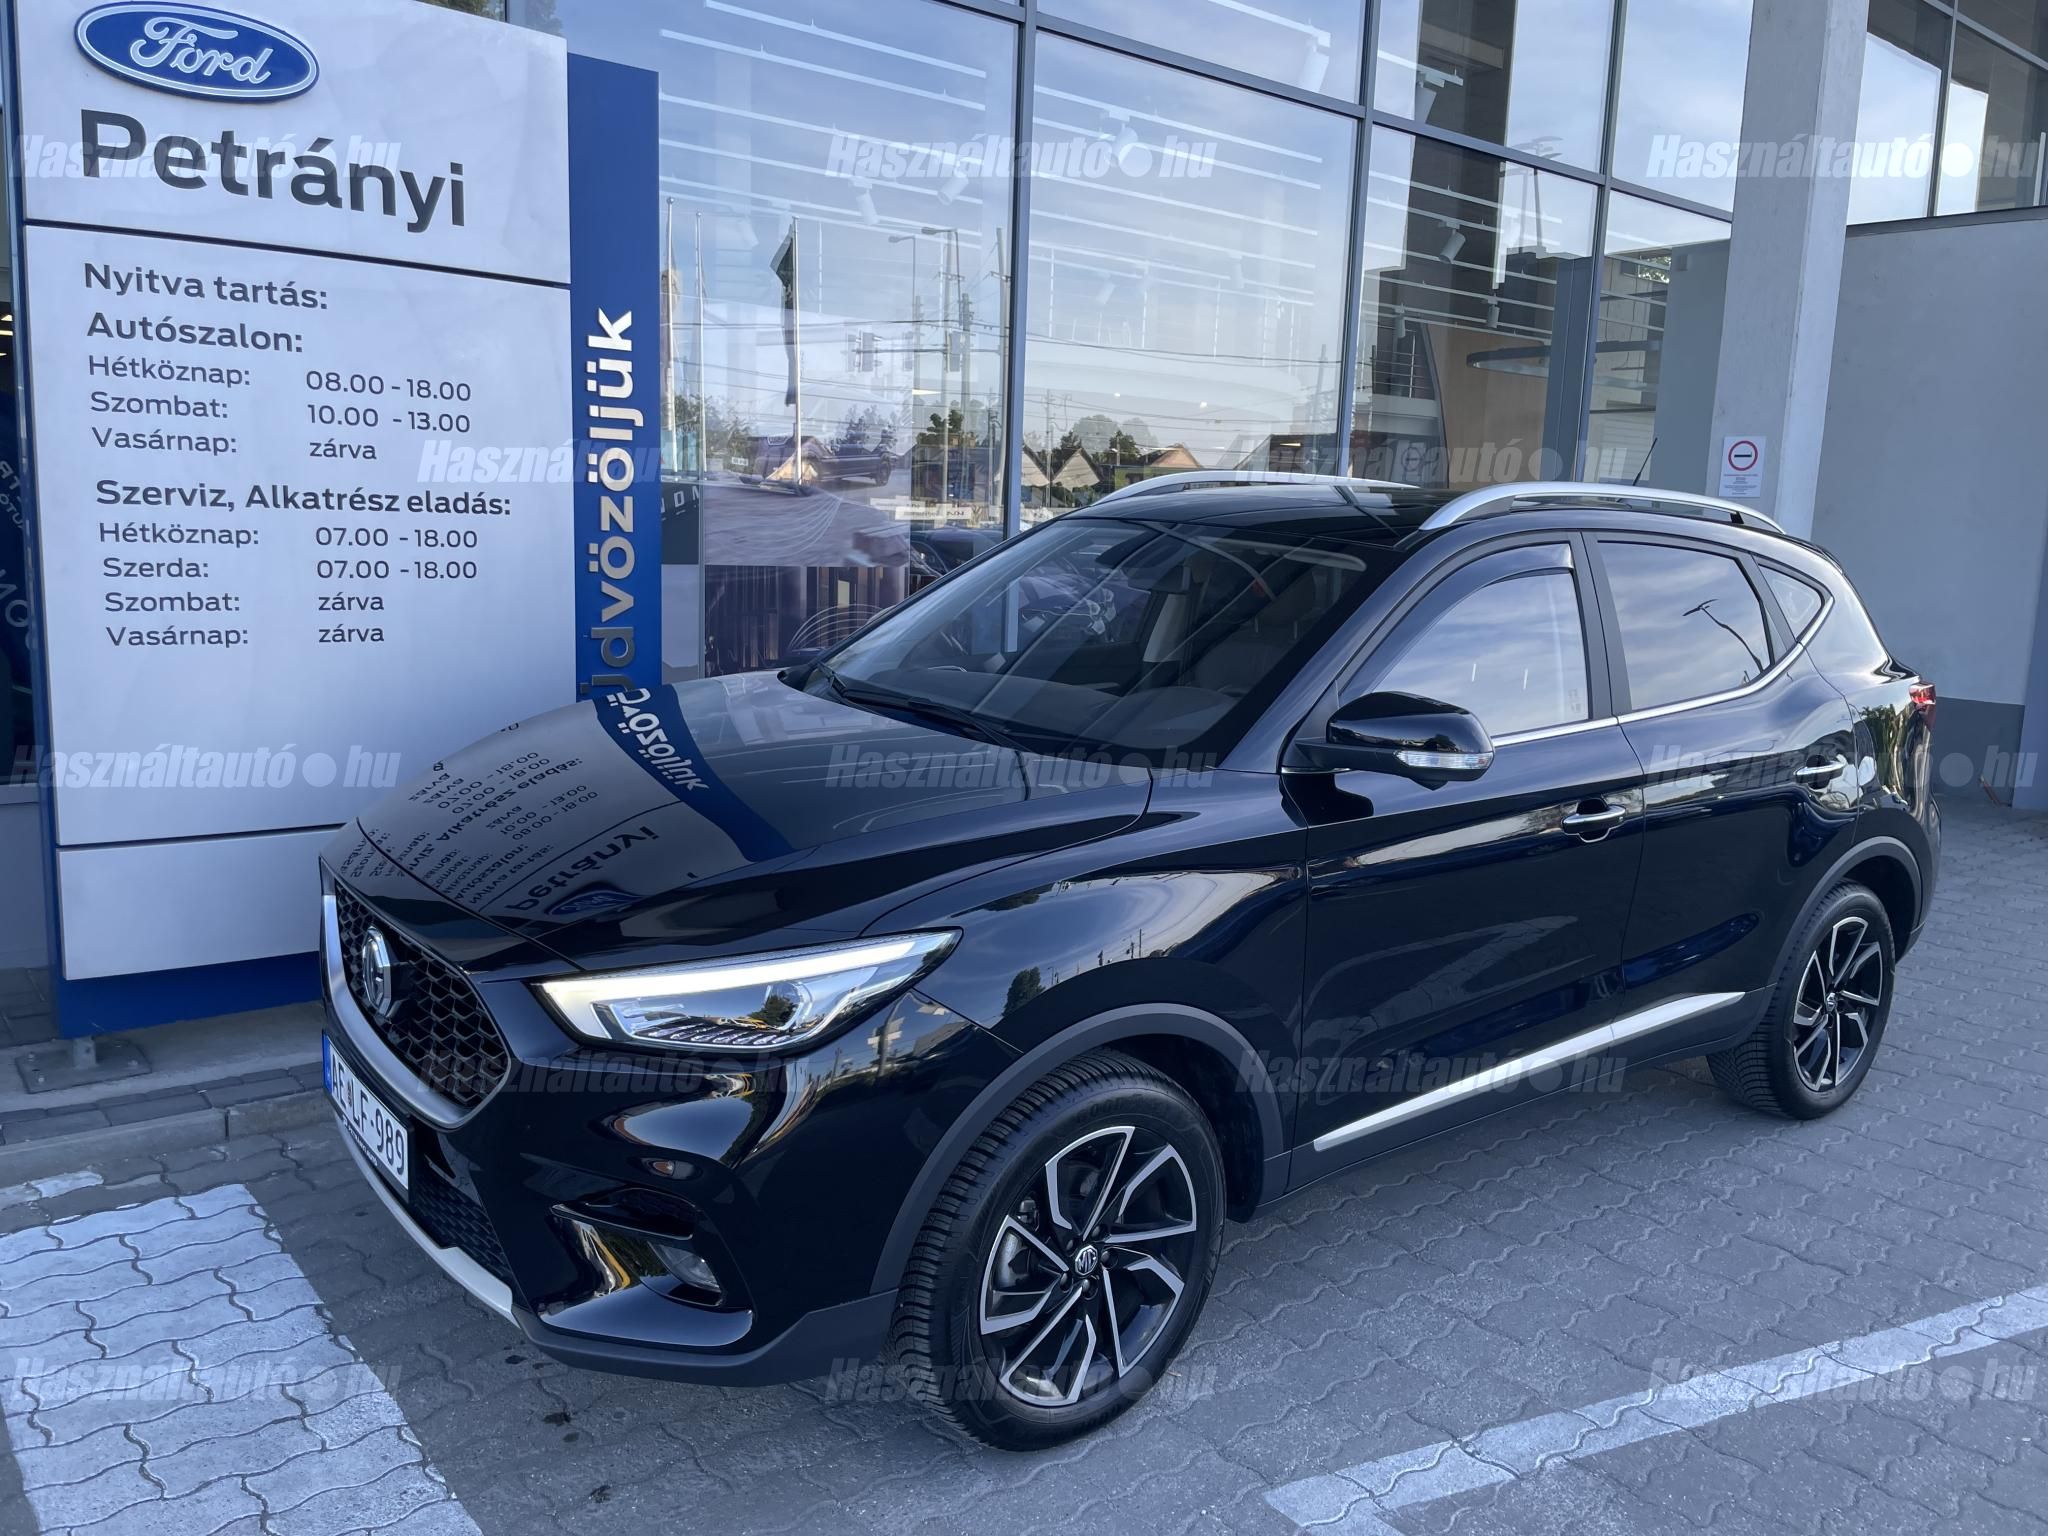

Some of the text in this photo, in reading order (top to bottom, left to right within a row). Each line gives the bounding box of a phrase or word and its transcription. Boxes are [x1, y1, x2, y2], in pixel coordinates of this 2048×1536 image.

[130, 15, 273, 85] Ford
[78, 109, 465, 234] Petrányi
[85, 263, 327, 310] Nyitva tartás:
[87, 312, 303, 353] Autószalon:
[89, 355, 250, 388] Hétköznap:
[306, 370, 384, 395] 08.00
[90, 391, 228, 419] Szombat:
[307, 404, 379, 428] 10.00
[91, 426, 237, 456] Vasárnap:
[309, 438, 377, 460] zárva
[96, 479, 511, 516] Szerviz, Alkatrész eladás:
[99, 521, 259, 549] Hétköznap:
[315, 526, 389, 548] 07.00
[103, 557, 209, 579] Szerda:
[316, 559, 390, 579] 07.00
[105, 591, 240, 613] Szombat:
[318, 591, 385, 611] zárva
[106, 625, 248, 649] Vasárnap:
[318, 623, 385, 643] zárva
[332, 1053, 347, 1110] AE
